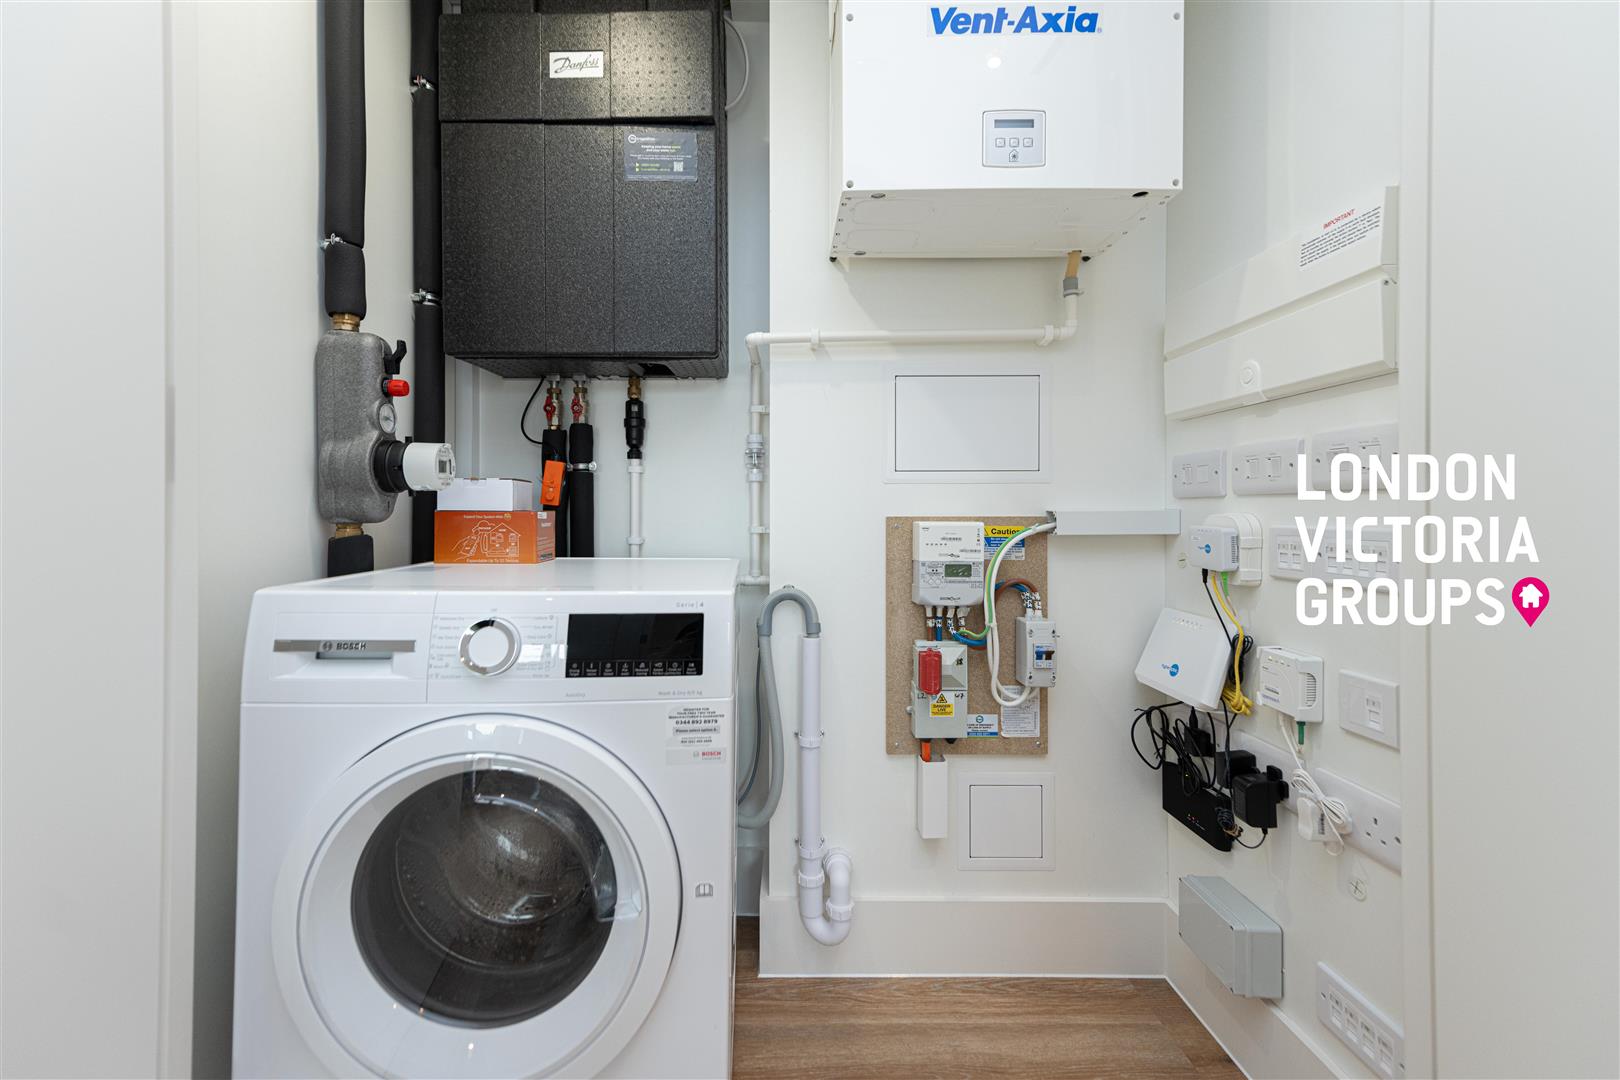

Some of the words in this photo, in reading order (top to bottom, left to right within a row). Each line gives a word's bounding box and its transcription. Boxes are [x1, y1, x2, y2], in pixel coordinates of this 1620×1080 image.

[930, 6, 1098, 35] Vent-Axia
[553, 54, 600, 74] Danfoss
[1322, 208, 1355, 229] IMPORTANT
[336, 642, 367, 650] BOSCH
